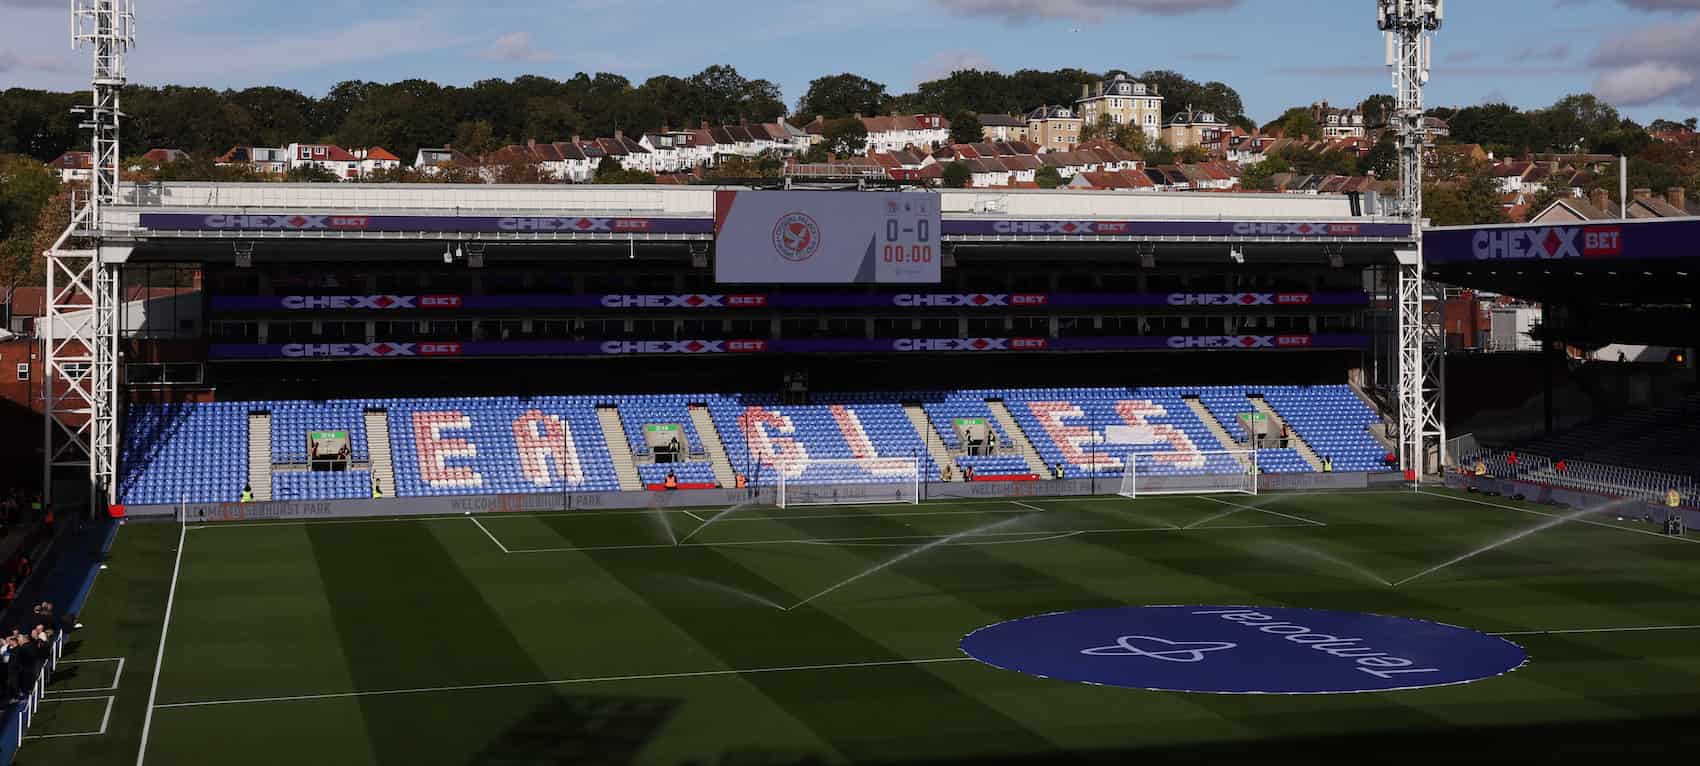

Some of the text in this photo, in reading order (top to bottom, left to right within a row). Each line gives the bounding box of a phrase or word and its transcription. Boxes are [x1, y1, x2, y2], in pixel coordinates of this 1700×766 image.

[204, 214, 368, 228] CHEXX BET
[498, 217, 648, 230] CHEXX BET
[993, 221, 1127, 233] CHEXX BET
[1233, 223, 1328, 234] CHEXX
[1472, 227, 1620, 260] CHEXX BET
[884, 244, 931, 263] 00:00
[281, 295, 460, 309] CHEXX BET
[601, 295, 764, 307] CHEXX BET
[893, 294, 1045, 306] CHEXX BET
[1167, 293, 1309, 305] CHEXX BET
[601, 340, 764, 353] CHEXX BET
[893, 338, 1045, 351] CHEXX BET
[1167, 336, 1309, 348] CHEXX BET
[281, 342, 460, 357] CHEXX BET
[304, 501, 331, 514] PARK
[1191, 608, 1440, 679] Temporal
